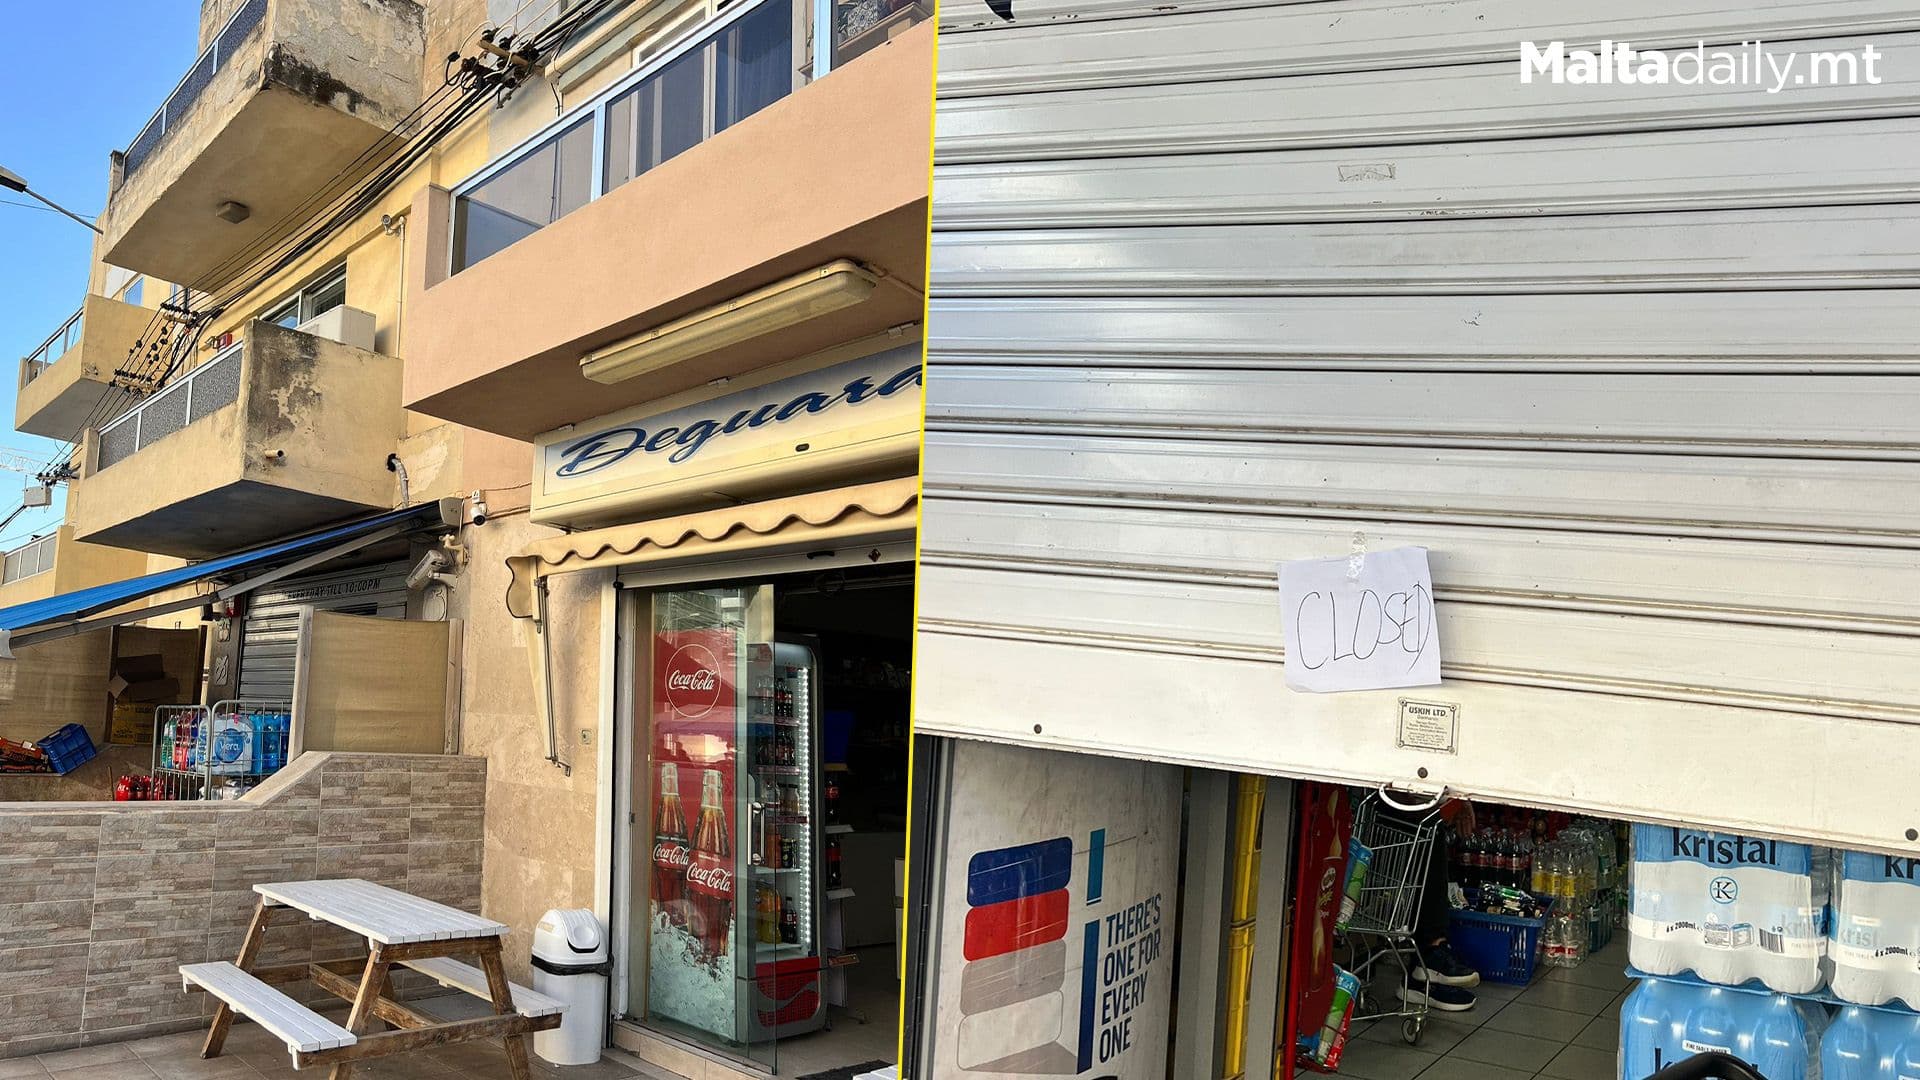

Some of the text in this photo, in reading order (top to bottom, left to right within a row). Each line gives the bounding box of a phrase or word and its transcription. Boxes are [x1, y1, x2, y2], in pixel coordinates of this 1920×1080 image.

[326, 583, 343, 595] TILL
[1296, 581, 1432, 675] CLOSED
[668, 669, 716, 690] Coca-Cola
[1408, 706, 1431, 715] USKIN
[652, 843, 691, 866] Coca-Cola
[1672, 827, 1777, 866] kristal
[686, 862, 732, 892] Coca-Cola
[1106, 893, 1162, 948] THERE'S
[1103, 928, 1161, 987] ONE FOR
[1101, 970, 1148, 1026] EVERY
[1100, 1016, 1132, 1063] ONE
